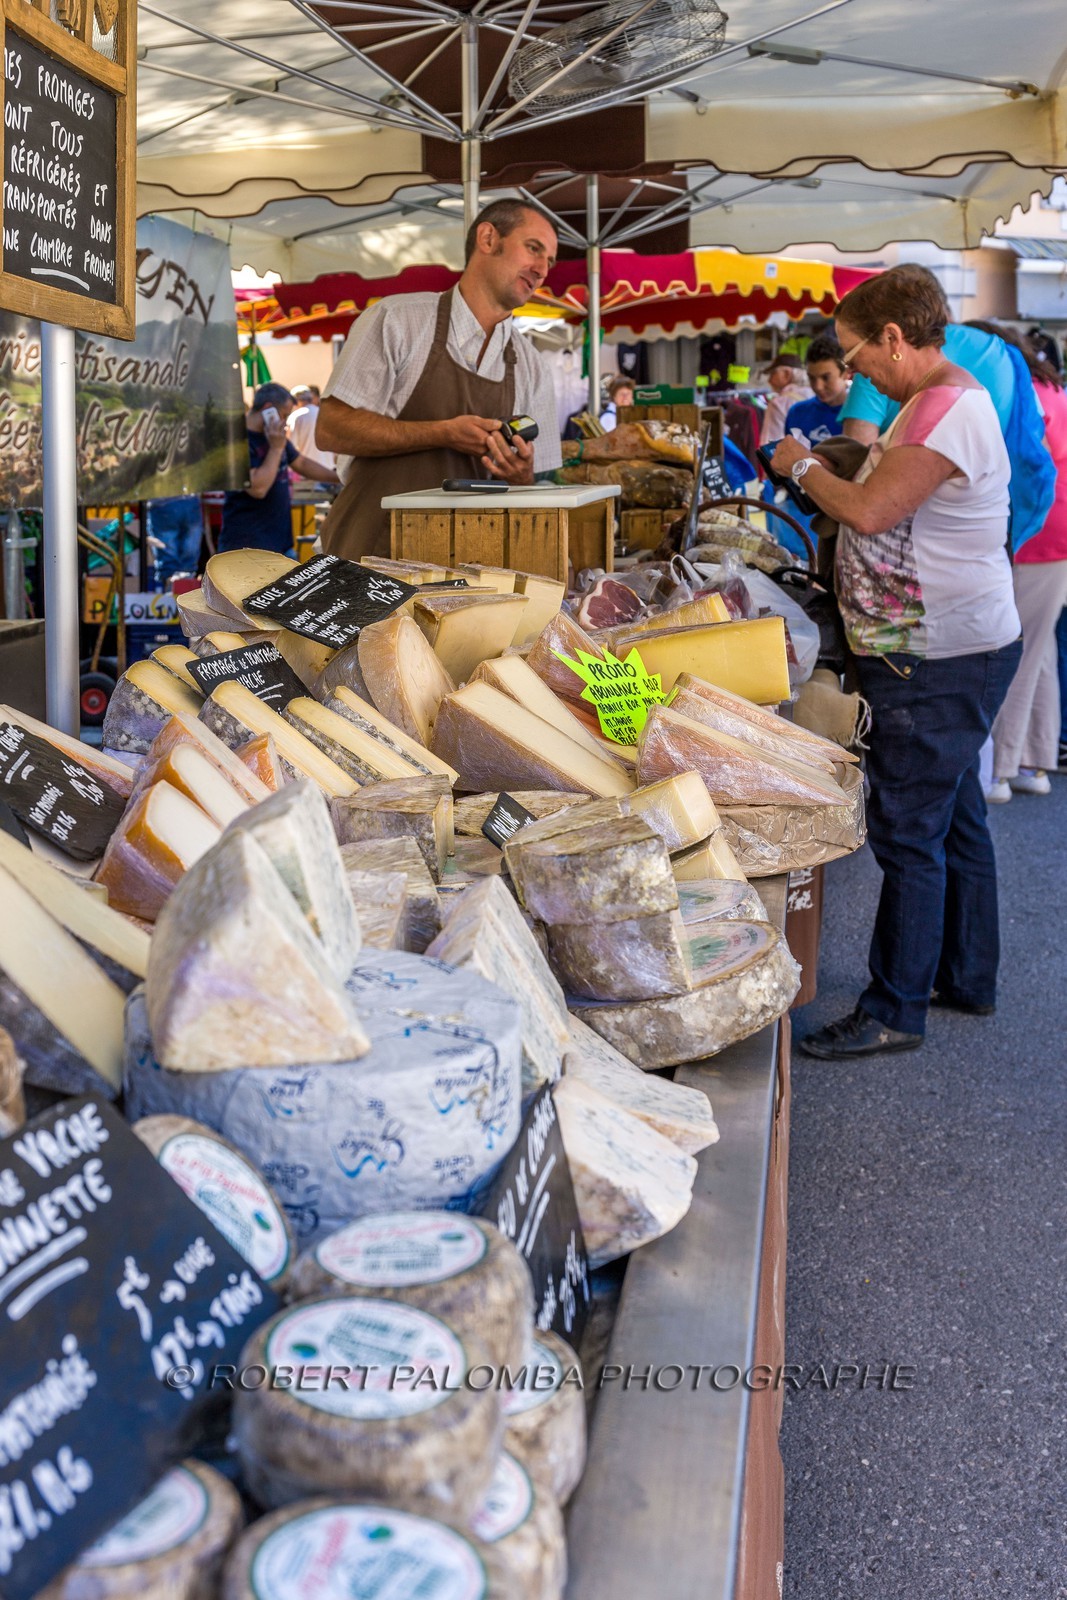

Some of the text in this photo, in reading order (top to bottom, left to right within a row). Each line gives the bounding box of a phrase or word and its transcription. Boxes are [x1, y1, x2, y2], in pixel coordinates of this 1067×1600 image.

[38, 65, 95, 120] FROMAGES
[50, 121, 84, 157] TOUS
[94, 184, 108, 206] ET
[90, 215, 112, 243] DANS
[30, 232, 73, 267] CHAMBRE
[588, 662, 638, 682] PROMO
[588, 681, 641, 702] ABONDANCE
[12, 1102, 110, 1178] VACHE
